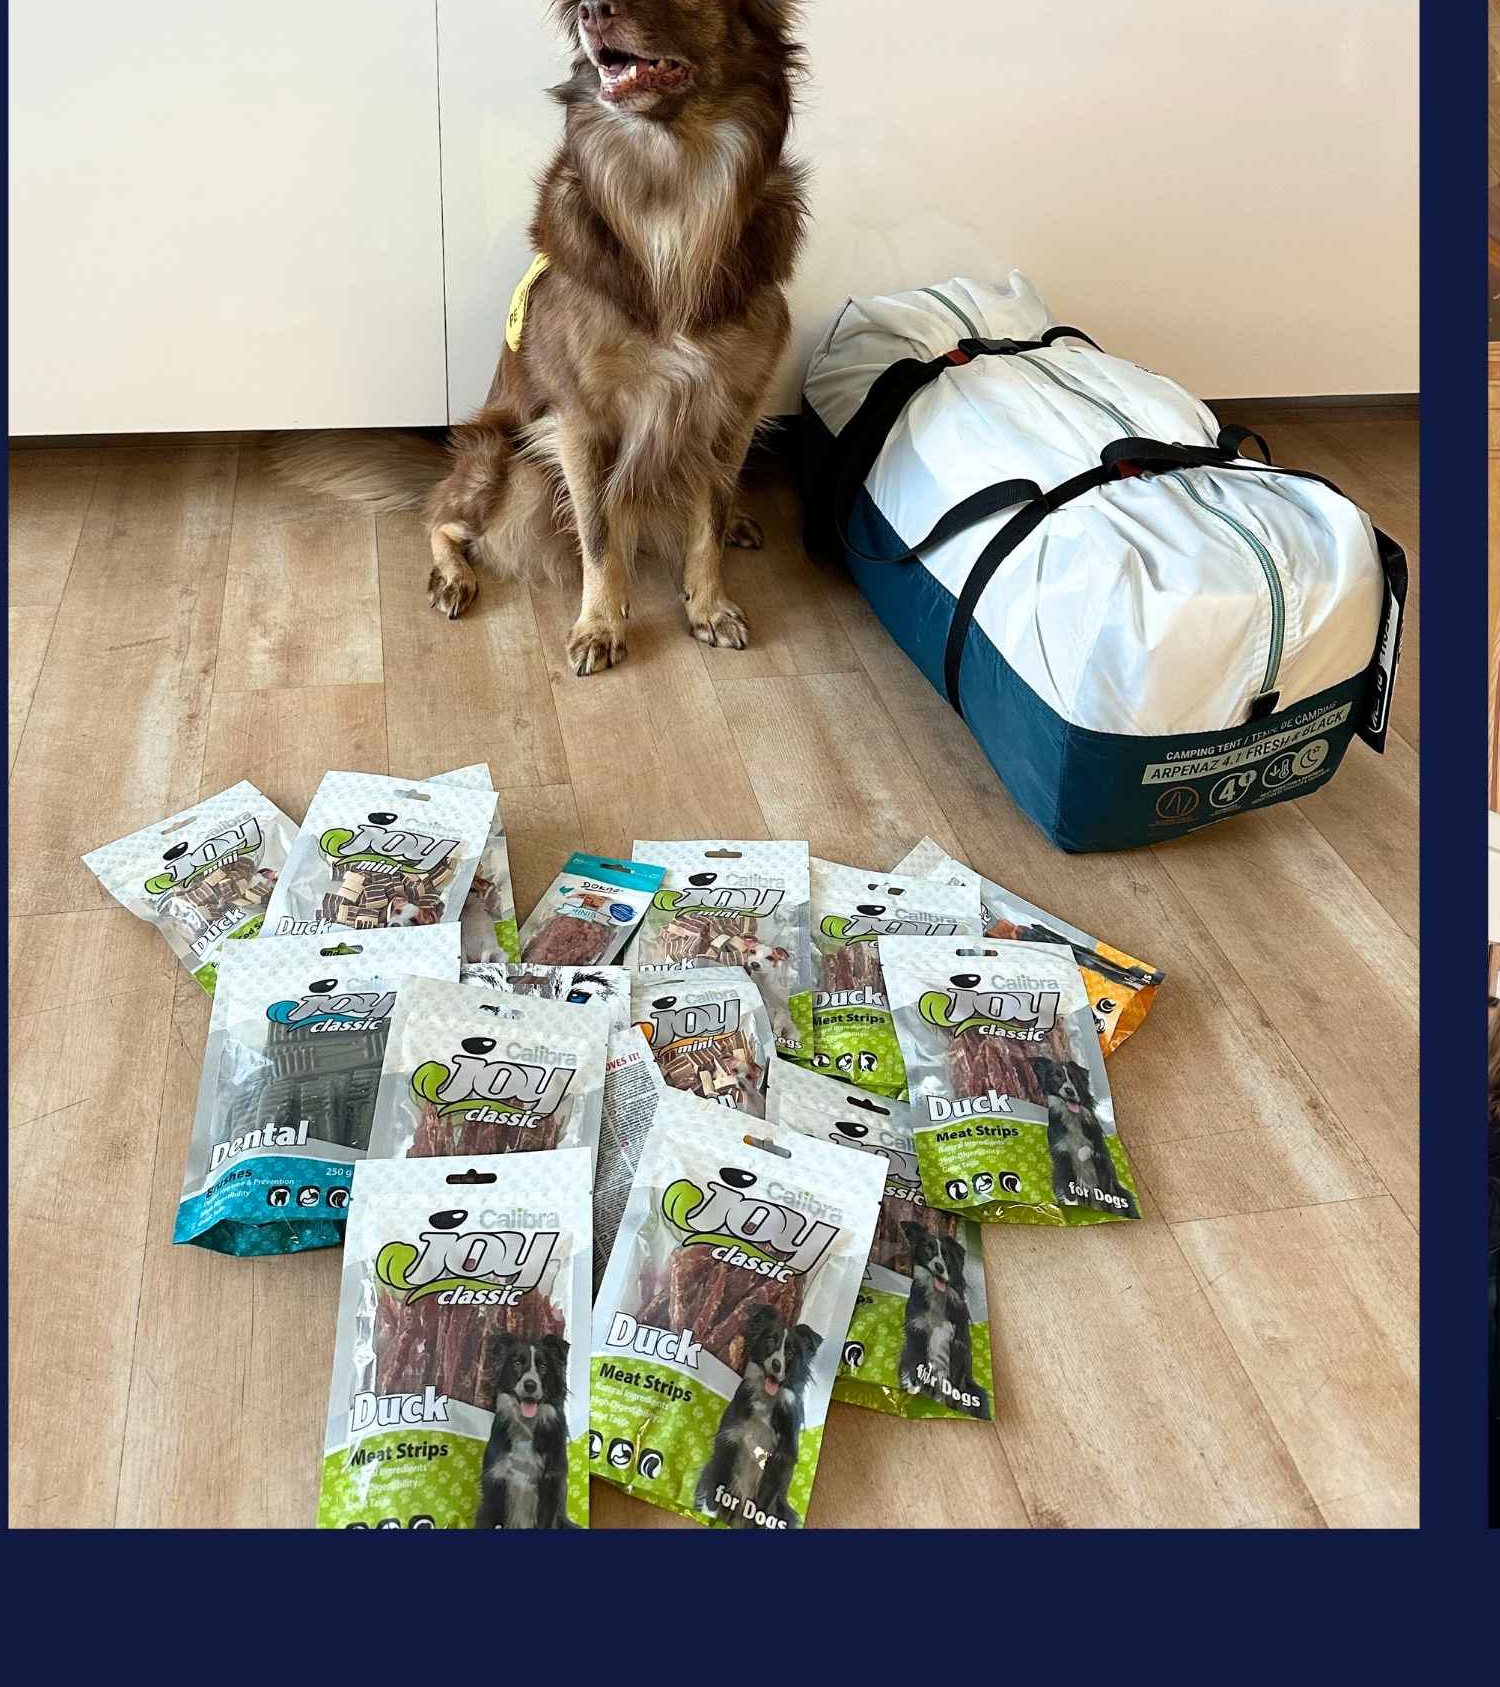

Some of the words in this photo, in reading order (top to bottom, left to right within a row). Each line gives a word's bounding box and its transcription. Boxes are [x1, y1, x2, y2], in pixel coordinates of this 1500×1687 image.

[1150, 762, 1218, 780] ARPENAZ
[1245, 737, 1290, 760] FRESH
[1302, 710, 1346, 737] BLACK
[1166, 745, 1215, 761] CAMPING
[1218, 737, 1243, 754] TENT
[356, 860, 402, 876] mini
[723, 872, 786, 889] Calibra
[275, 915, 333, 936] Duck
[894, 908, 957, 924] Calibra
[189, 906, 246, 957] Duck
[990, 974, 1059, 991] Calibra
[685, 987, 739, 1006] Calibra
[814, 985, 886, 1009] Duck
[310, 1017, 383, 1033] classic
[813, 1013, 843, 1026] Meat
[843, 1012, 886, 1025] Strips
[978, 1023, 1046, 1042] classic
[505, 1041, 577, 1066] Calibra
[676, 1037, 715, 1054] mini
[927, 1089, 1013, 1121] Duck
[464, 1106, 544, 1130] classic
[879, 1131, 916, 1154] Cali
[936, 1127, 974, 1143] Meat
[976, 1124, 1019, 1139] Strips
[208, 1120, 309, 1173] Dental
[325, 1167, 344, 1176] 250
[765, 1180, 843, 1222] Calibra
[1067, 1180, 1088, 1199] for
[1092, 1187, 1129, 1209] Dogs
[478, 1208, 561, 1230] Calibra
[710, 1245, 794, 1284] classic
[438, 1286, 526, 1307] classic
[605, 1311, 703, 1370] Duck
[599, 1362, 642, 1387] Meat
[643, 1374, 693, 1402] Strips
[941, 1375, 982, 1408] Dogs
[350, 1385, 450, 1432] Duck
[350, 1446, 392, 1466] Meat
[396, 1441, 449, 1461] Strips
[713, 1484, 740, 1513] for
[743, 1498, 788, 1529] Dogs
